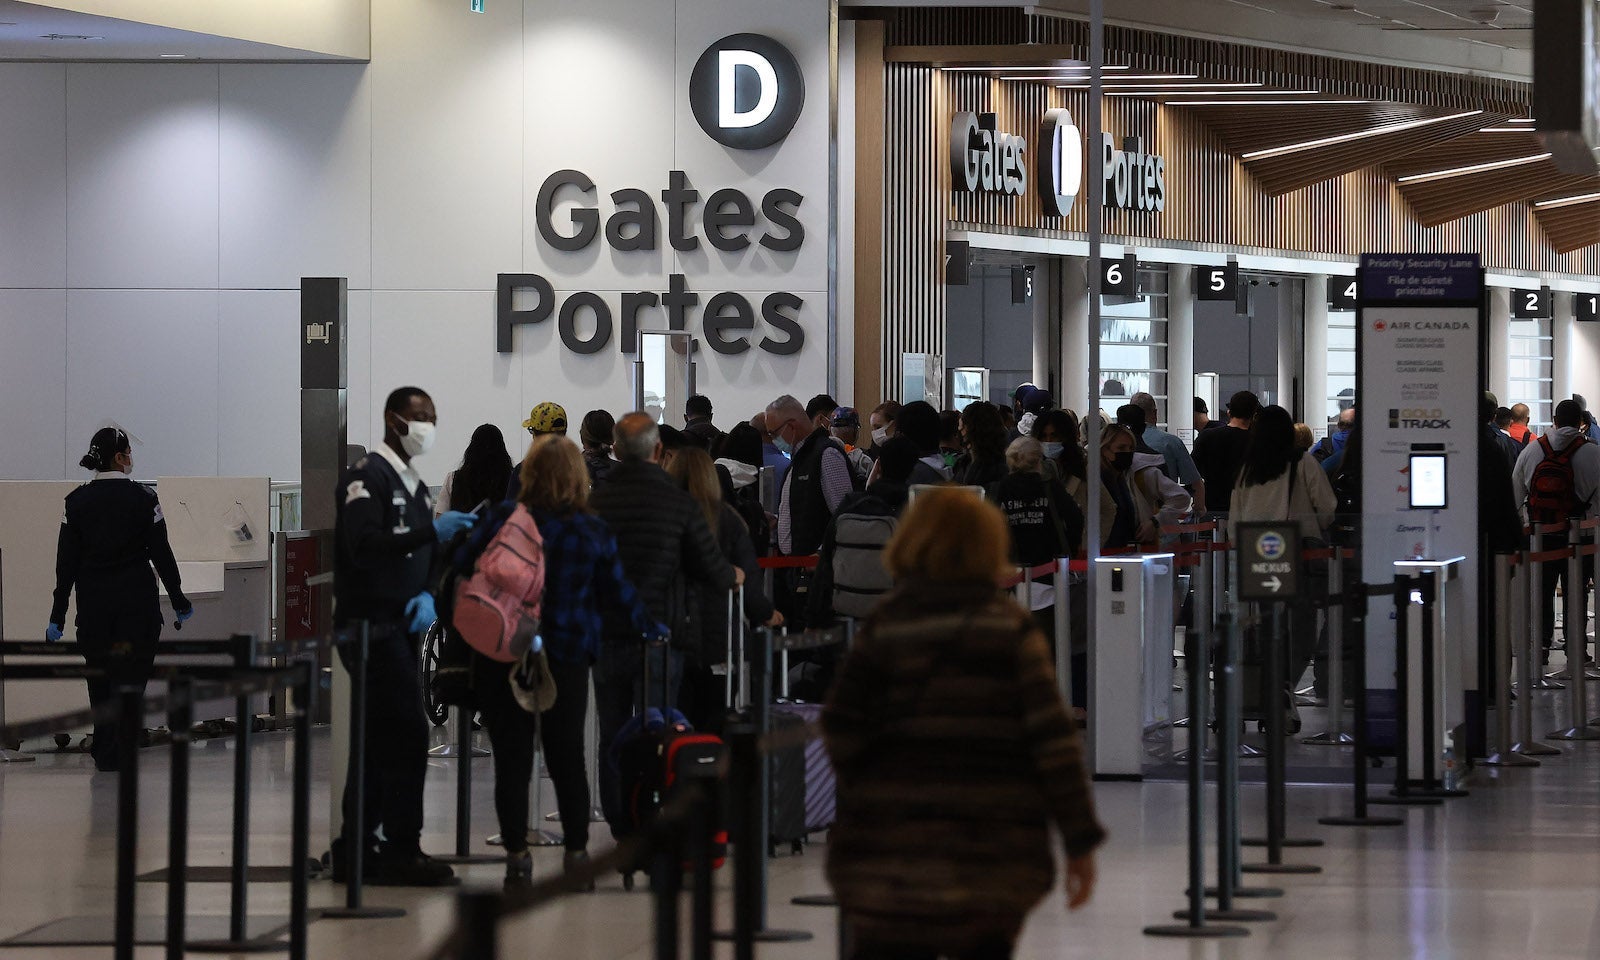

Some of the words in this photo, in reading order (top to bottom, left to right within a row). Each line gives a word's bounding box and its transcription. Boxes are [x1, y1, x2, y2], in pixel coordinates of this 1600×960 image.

[718, 49, 778, 128] D
[952, 111, 1026, 196] Gates
[1101, 132, 1165, 212] Portes
[535, 169, 804, 251] Gates
[1368, 259, 1405, 270] Priority
[1407, 259, 1448, 270] Security
[1450, 259, 1473, 268] Lane
[1106, 264, 1122, 284] 6
[1210, 271, 1225, 291] 5
[1388, 276, 1406, 285] File
[1408, 275, 1420, 285] de
[1344, 281, 1357, 300] 4
[1395, 286, 1445, 297] prioritaire
[1525, 293, 1538, 311] 2
[1589, 297, 1597, 315] 1
[496, 273, 804, 354] Portes
[1390, 321, 1411, 330] AIR
[1414, 321, 1470, 330] CANADA
[1401, 408, 1442, 418] GOLD
[1401, 419, 1451, 429] TRACK
[1251, 562, 1291, 573] NEXUS
